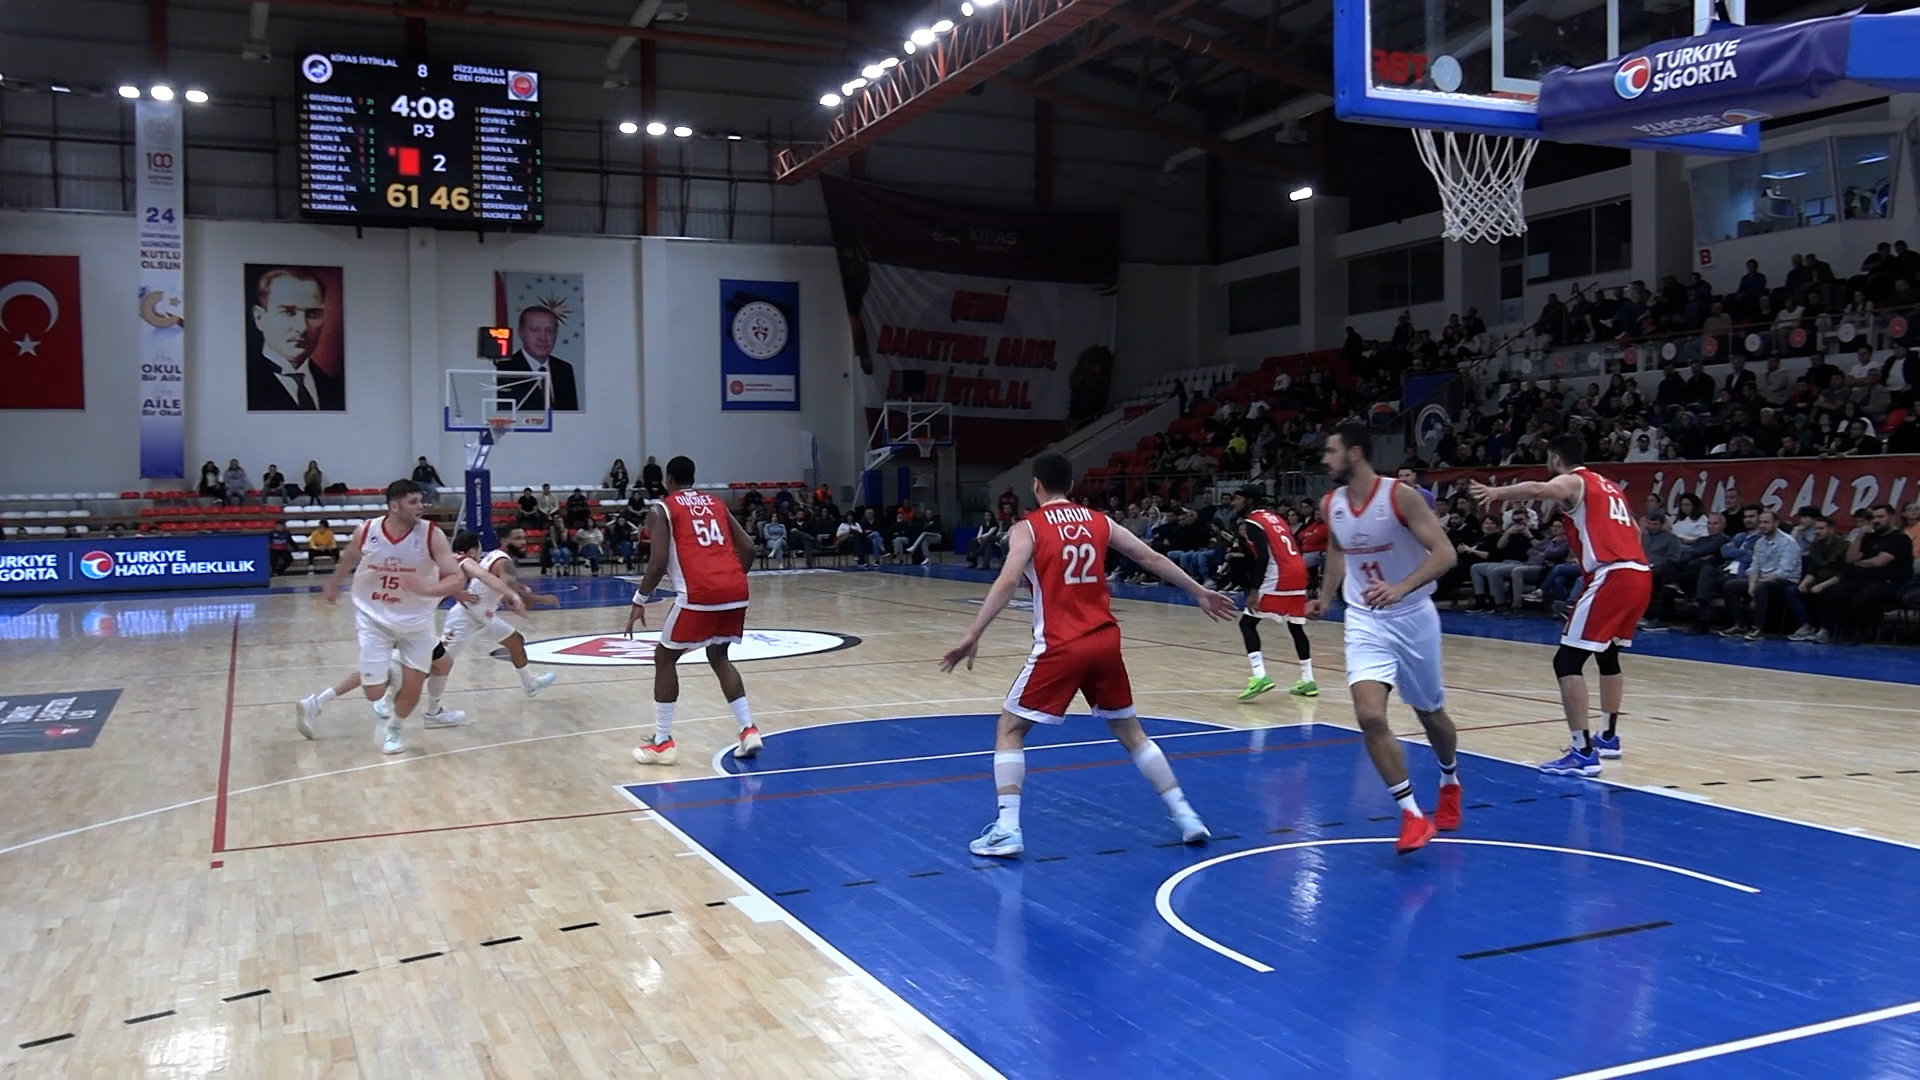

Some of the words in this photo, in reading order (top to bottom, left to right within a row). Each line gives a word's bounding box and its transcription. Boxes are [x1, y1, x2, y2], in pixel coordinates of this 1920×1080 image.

[359, 56, 398, 67] İSTİKLAL
[1655, 38, 1742, 71] TÜRKİYE
[417, 64, 428, 78] 8
[1652, 59, 1738, 93] SİGORTA
[474, 76, 506, 85] OSMAN
[391, 94, 455, 120] 4:08
[413, 123, 435, 138] P3
[147, 153, 173, 170] 100
[433, 154, 446, 172] 2
[386, 183, 419, 208] 61
[430, 186, 470, 211] 46
[146, 207, 175, 224] 24
[141, 250, 181, 260] KUTLU
[1699, 248, 1712, 265] B
[141, 260, 181, 270] OLSUN
[877, 324, 990, 366] BASKETBOL
[141, 364, 182, 374] OKUL
[143, 396, 181, 409] AİLE
[1044, 508, 1093, 525] HARUN
[1609, 496, 1631, 527] 44
[692, 519, 724, 547] 54
[1057, 525, 1092, 541] ICA
[1280, 535, 1297, 556] 2
[115, 550, 187, 564] TÜRKİYE
[1062, 543, 1098, 585] 22
[115, 562, 166, 577] HAYAT
[171, 560, 256, 575] EMEKLİLİK
[380, 576, 400, 590] 15
